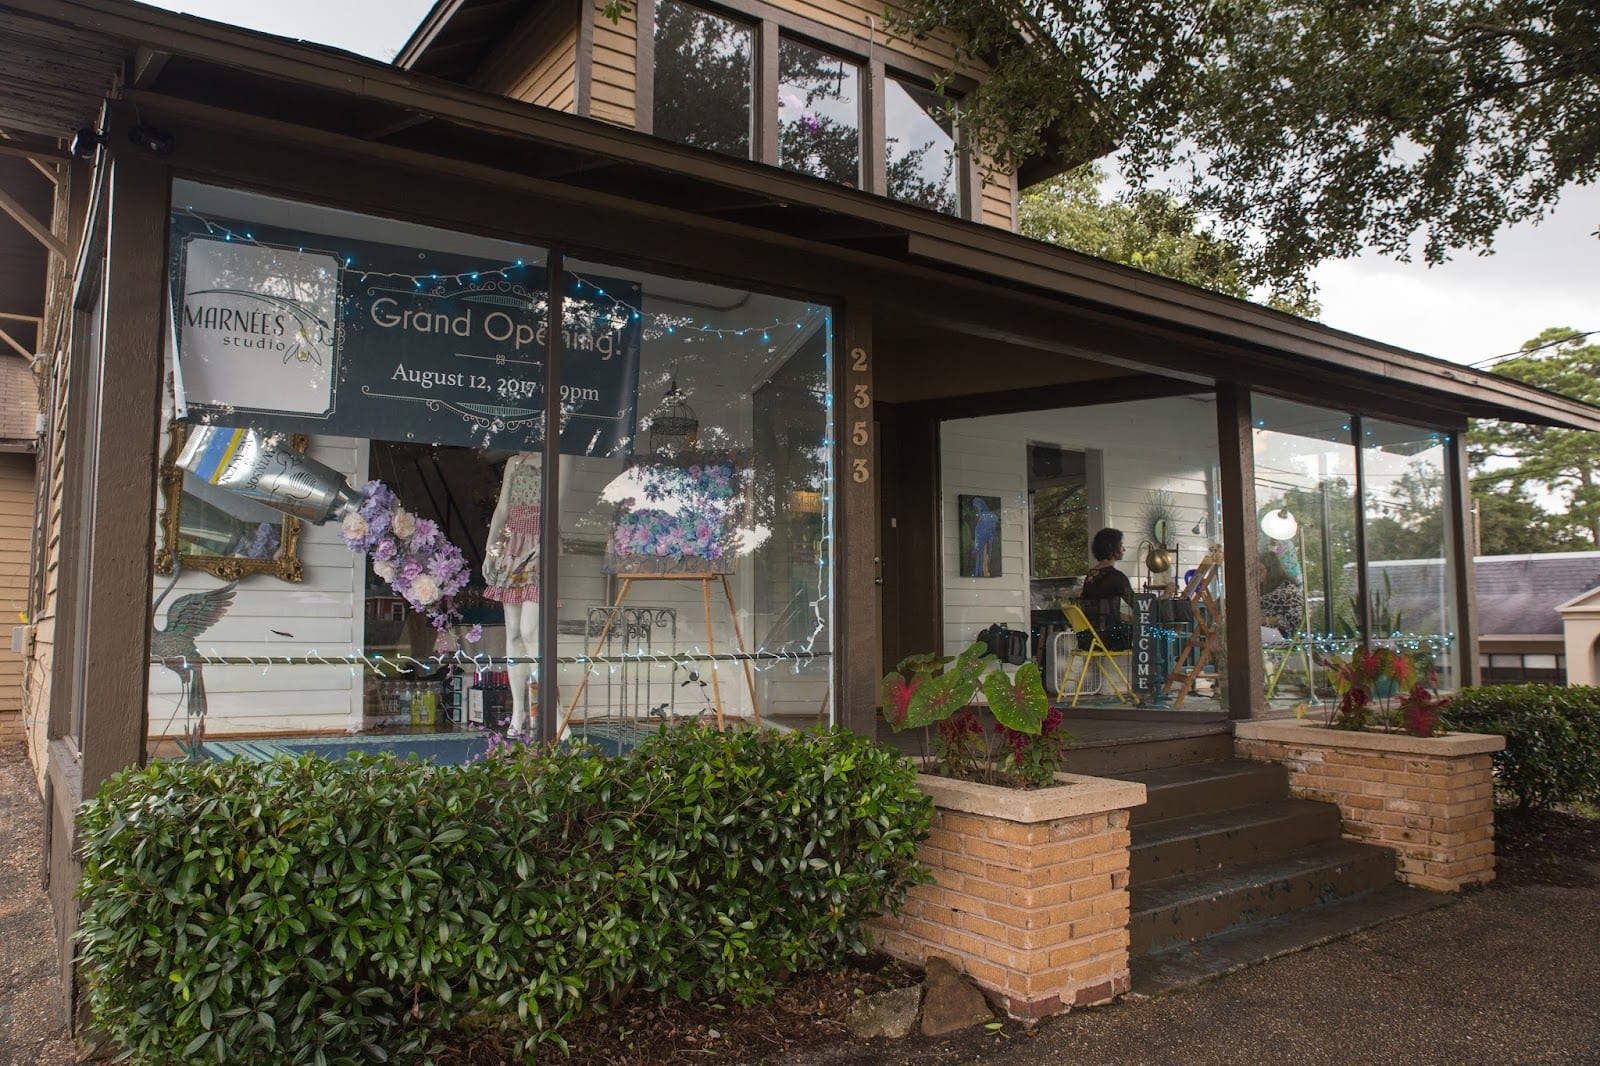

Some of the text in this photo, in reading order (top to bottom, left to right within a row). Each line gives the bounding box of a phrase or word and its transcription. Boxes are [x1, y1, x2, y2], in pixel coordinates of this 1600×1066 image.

[370, 297, 471, 337] Grand
[223, 336, 286, 351] studio
[392, 363, 464, 389] August
[469, 375, 491, 392] 12,
[497, 378, 536, 398] 2017
[851, 348, 870, 483] 2353
[221, 440, 254, 483] NEWTON
[245, 450, 276, 490] WINSOR
[1137, 599, 1152, 689] WELCOME
